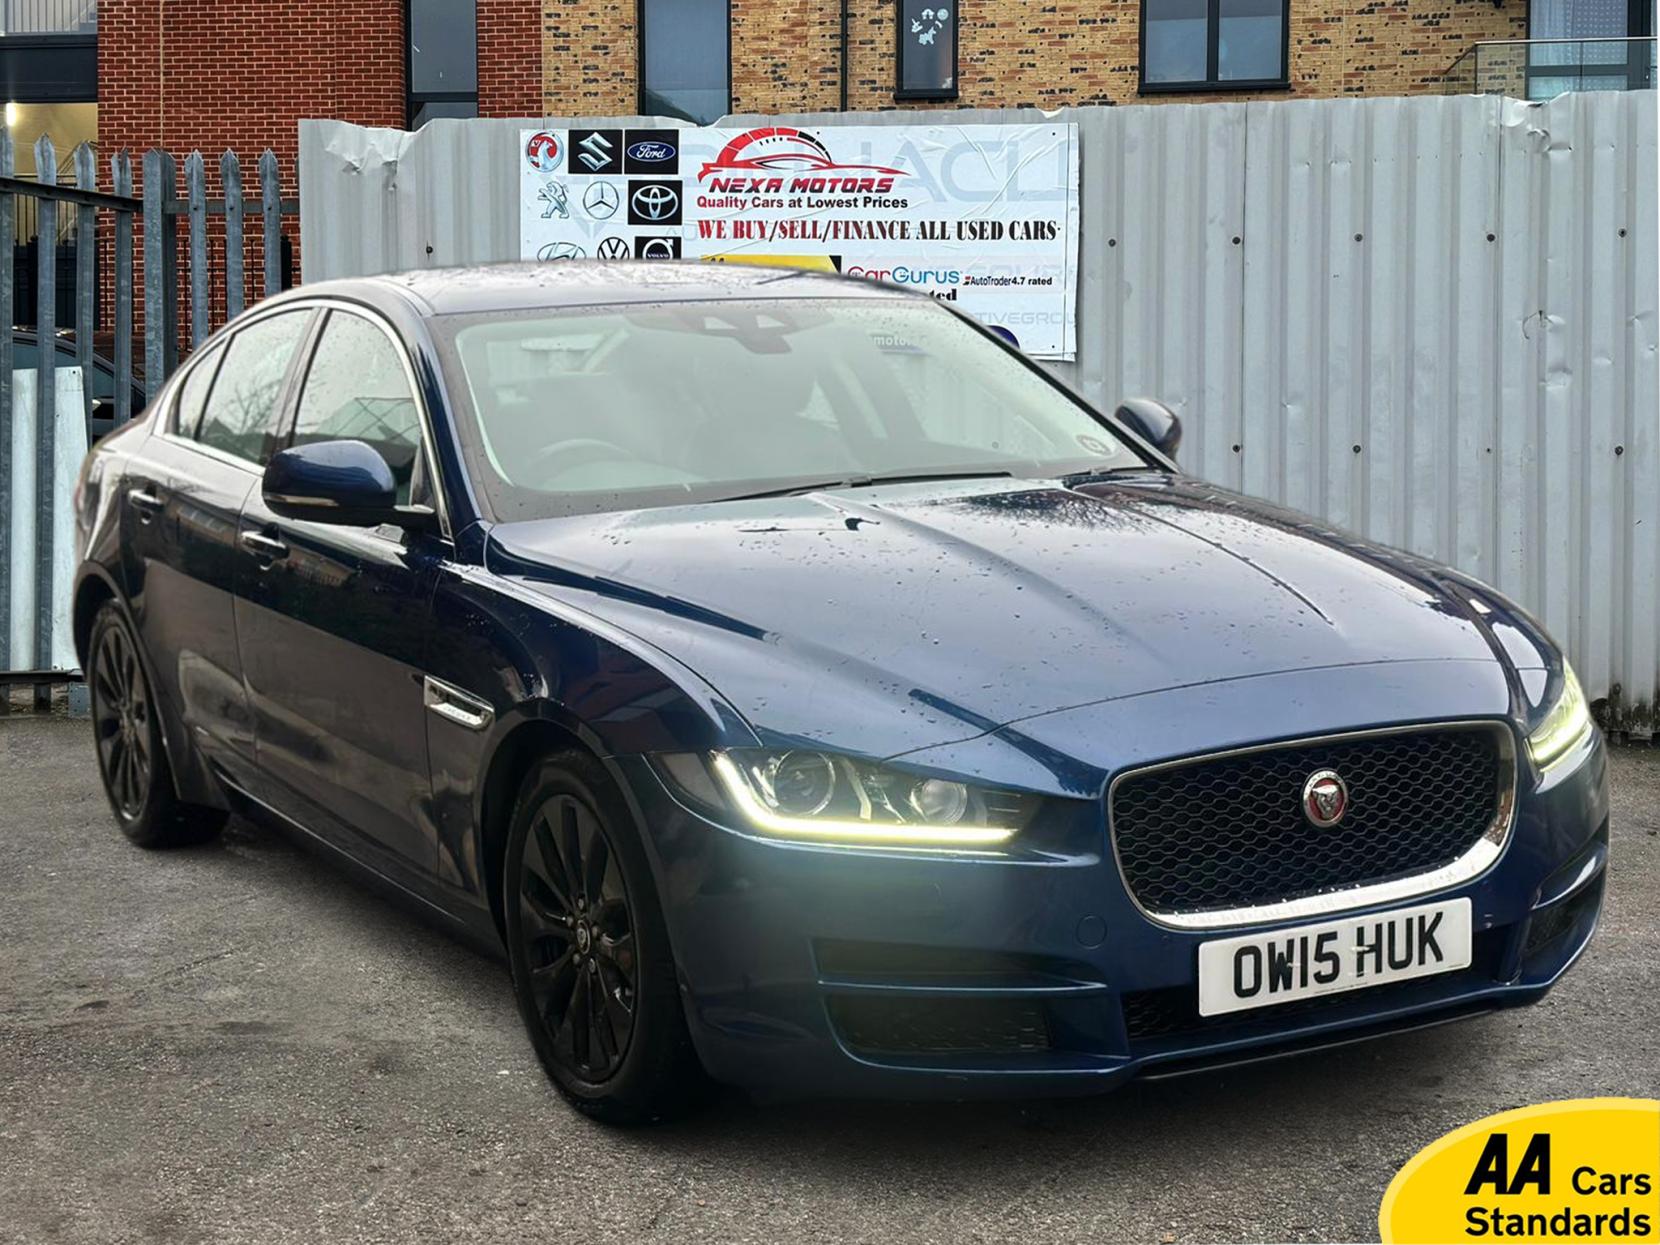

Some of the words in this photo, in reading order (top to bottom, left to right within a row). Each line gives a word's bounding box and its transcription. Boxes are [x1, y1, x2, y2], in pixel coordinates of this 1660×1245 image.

[636, 142, 666, 159] Ford
[709, 178, 783, 193] NEXA
[789, 178, 894, 193] MOTORS
[697, 196, 746, 210] Quality
[752, 196, 783, 208] Cars
[788, 197, 802, 208] at
[807, 196, 858, 208] Lowest
[863, 196, 908, 208] Prices
[698, 220, 727, 239] WE
[916, 221, 950, 240] ALL
[956, 221, 1003, 240] USED
[1009, 221, 1056, 240] CARS
[1028, 277, 1052, 285] rated
[1233, 931, 1341, 999] OW15
[1356, 911, 1444, 978] HUK
